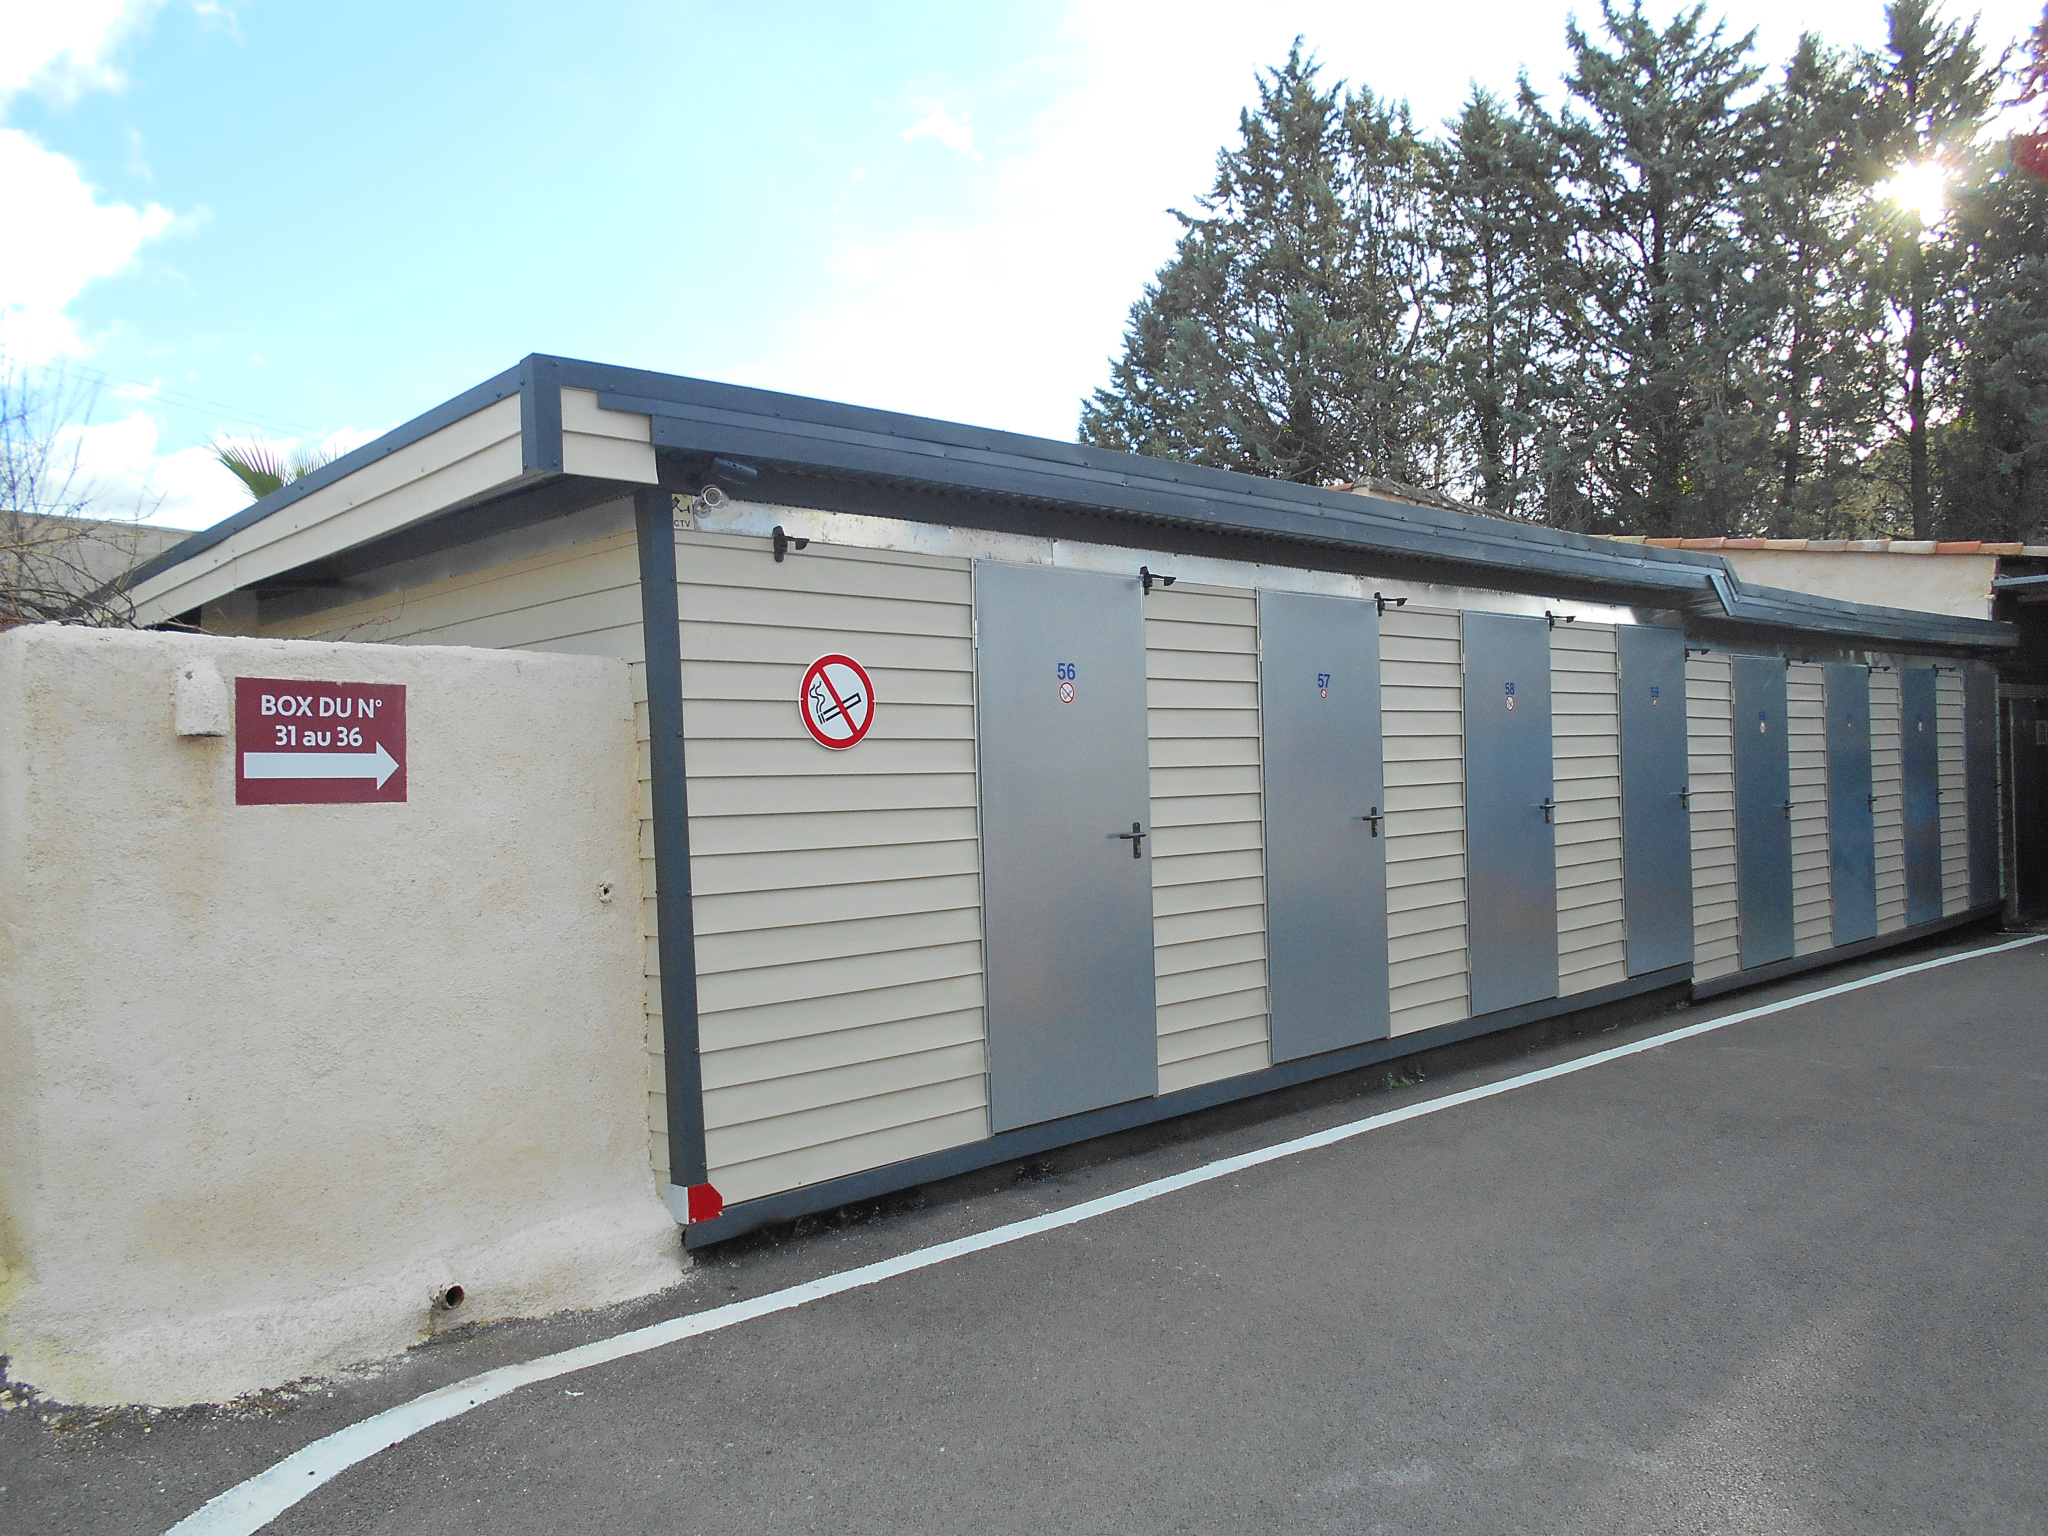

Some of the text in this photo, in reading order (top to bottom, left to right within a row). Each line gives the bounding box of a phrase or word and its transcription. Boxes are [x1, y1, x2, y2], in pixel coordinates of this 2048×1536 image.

[673, 519, 691, 528] CTV
[1057, 662, 1076, 680] 56
[1317, 673, 1331, 688] 57
[1505, 682, 1515, 695] 58
[261, 694, 383, 719] BOX DU N°
[275, 725, 363, 747] 31 au 36
